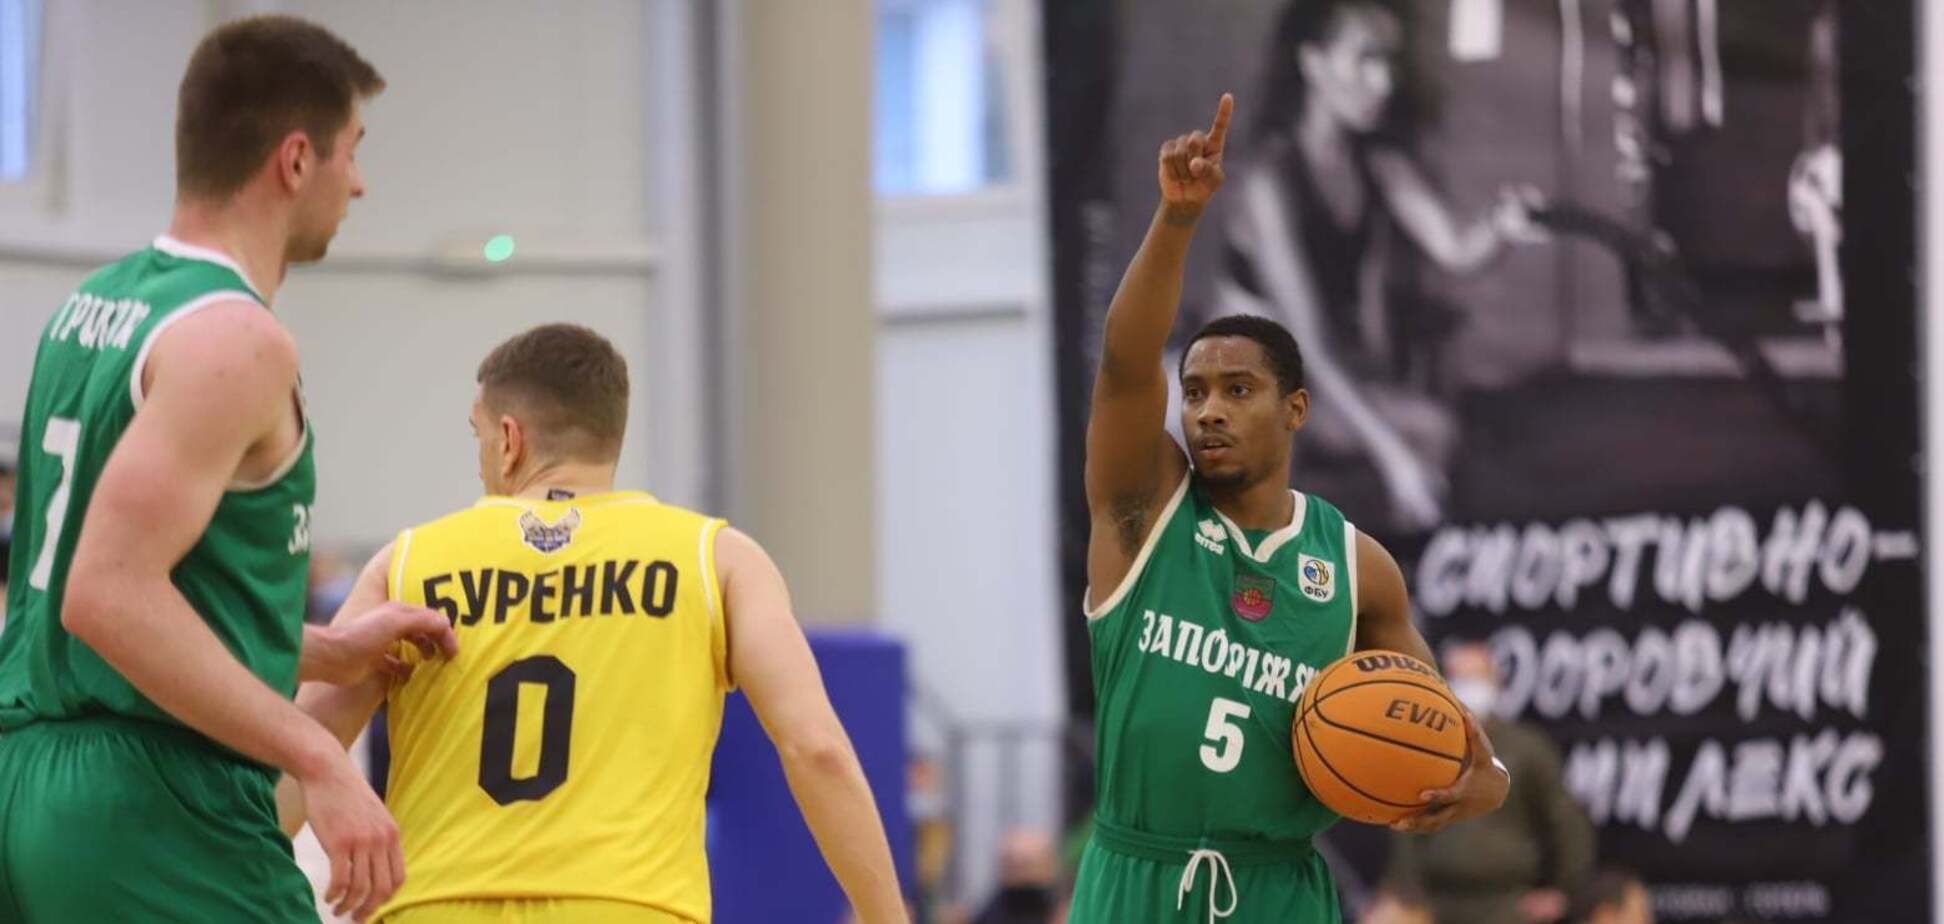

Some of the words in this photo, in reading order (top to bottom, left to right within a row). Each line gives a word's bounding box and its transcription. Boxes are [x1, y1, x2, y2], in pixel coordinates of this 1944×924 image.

[422, 559, 679, 628] БУРЕНКО
[1304, 585, 1329, 599] ФБУ
[478, 654, 577, 807] 0
[1199, 696, 1252, 774] 5
[1385, 698, 1447, 733] EVO
